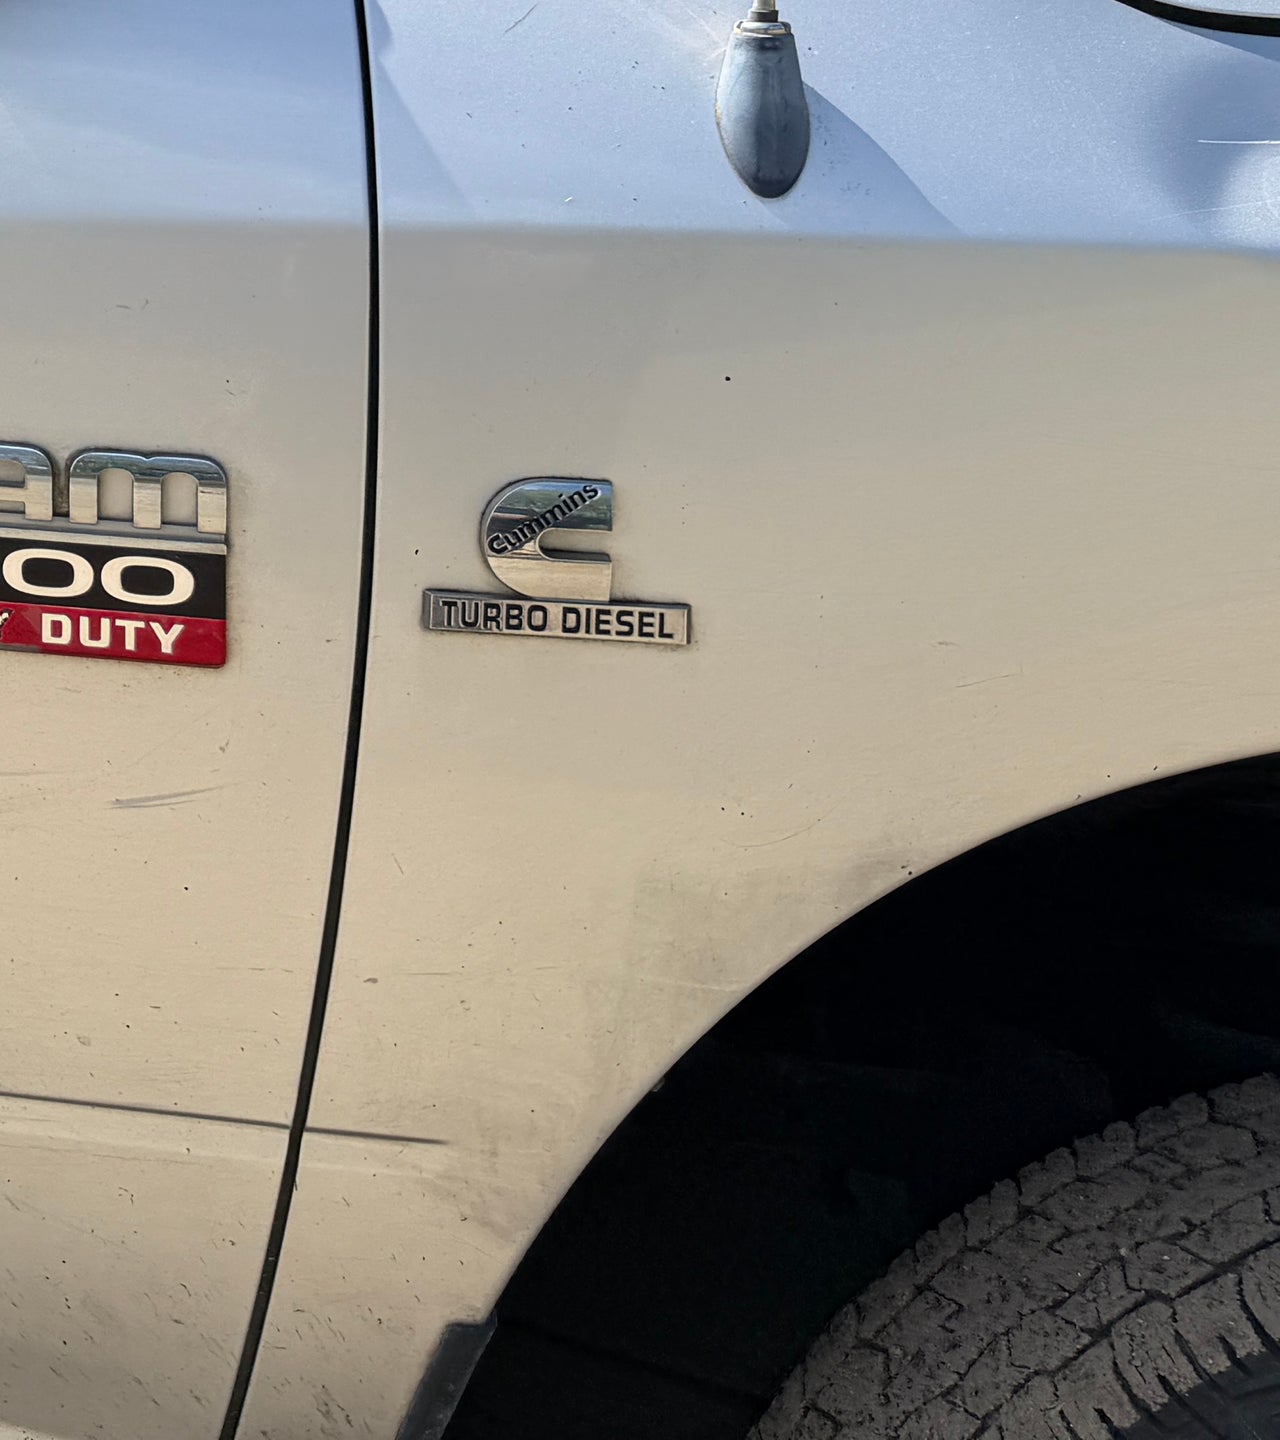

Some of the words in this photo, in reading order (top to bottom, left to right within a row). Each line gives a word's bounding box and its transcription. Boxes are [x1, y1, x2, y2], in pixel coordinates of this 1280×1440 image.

[487, 484, 600, 555] Cummins
[41, 613, 185, 654] DUTY
[441, 600, 547, 631] TURBO
[561, 606, 674, 639] DIESEL
